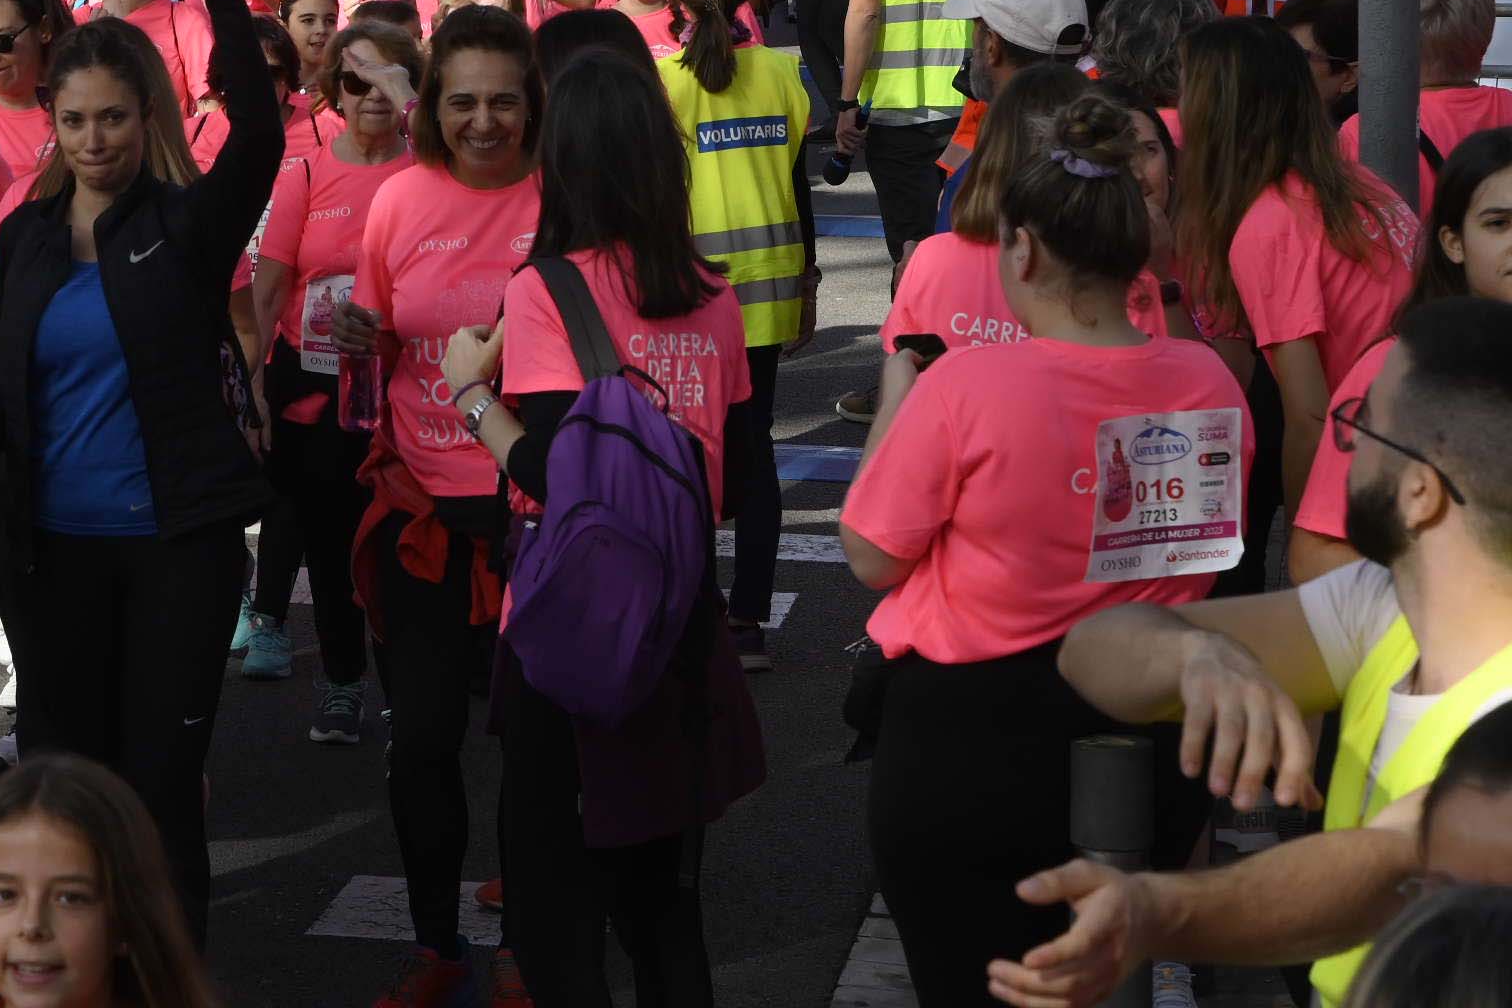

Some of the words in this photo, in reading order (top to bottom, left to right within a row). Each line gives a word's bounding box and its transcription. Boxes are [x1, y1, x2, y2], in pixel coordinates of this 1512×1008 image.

[699, 123, 786, 145] VOLUNTARIS
[308, 206, 351, 221] OYSHO
[629, 332, 718, 357] CARRERA
[648, 358, 671, 381] DE
[677, 359, 701, 381] LA
[1198, 432, 1228, 441] SUMA
[1071, 467, 1099, 494] C
[1136, 477, 1185, 503] 016
[1139, 508, 1178, 525] 27213
[1156, 532, 1167, 540] LA
[1168, 528, 1200, 538] MUJER
[1178, 548, 1230, 561] Santander
[1100, 556, 1142, 572] OYSHO
